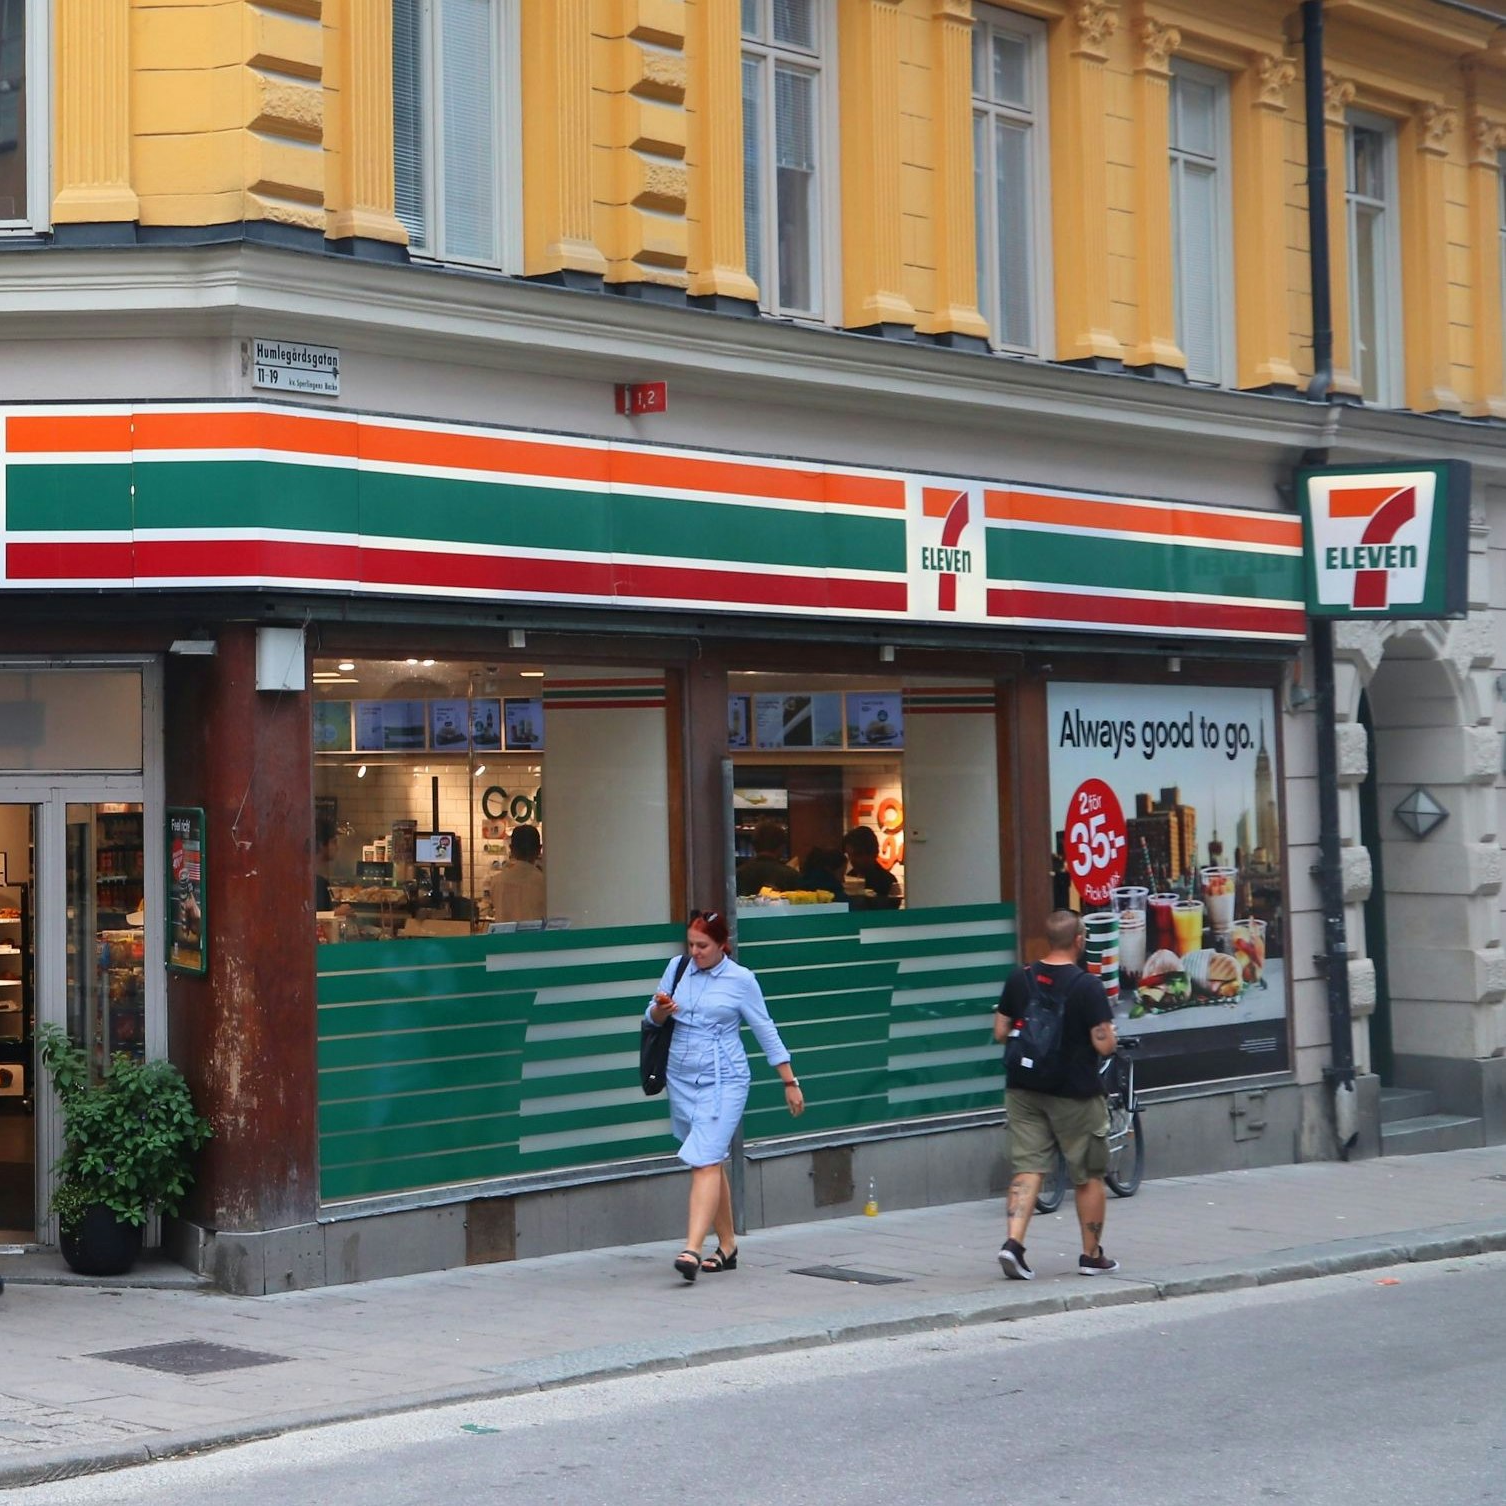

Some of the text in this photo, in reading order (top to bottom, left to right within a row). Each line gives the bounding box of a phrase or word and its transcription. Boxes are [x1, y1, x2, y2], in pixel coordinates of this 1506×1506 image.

[256, 343, 338, 368] Humlegårdsgatan
[257, 368, 279, 384] 11-19
[1059, 708, 1254, 761] Always good to go.
[1078, 791, 1102, 815] 2 för
[1070, 813, 1126, 877] 35:-
